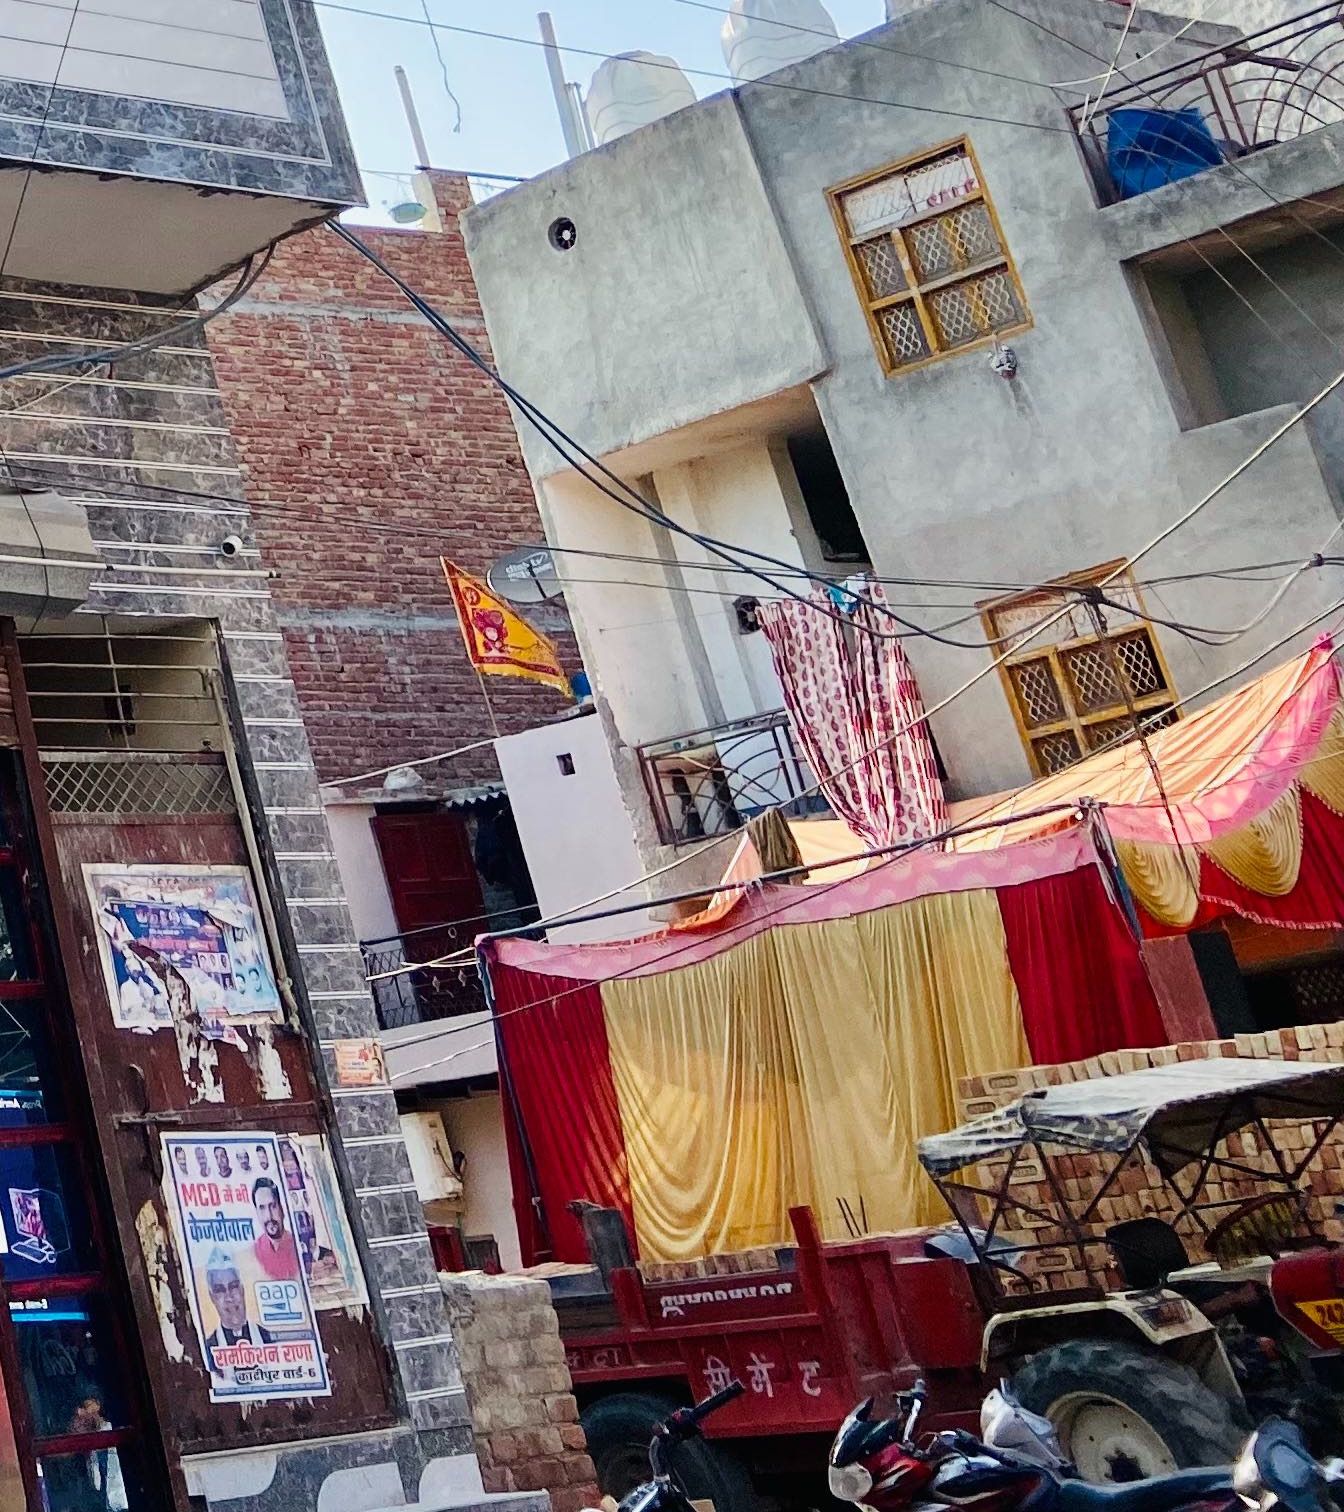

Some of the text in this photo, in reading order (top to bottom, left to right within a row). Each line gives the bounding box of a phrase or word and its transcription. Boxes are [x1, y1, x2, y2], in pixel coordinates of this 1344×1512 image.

[181, 1182, 220, 1207] MCD
[187, 1211, 256, 1243] केजरीवाल
[213, 1339, 281, 1368] रामकिशन
